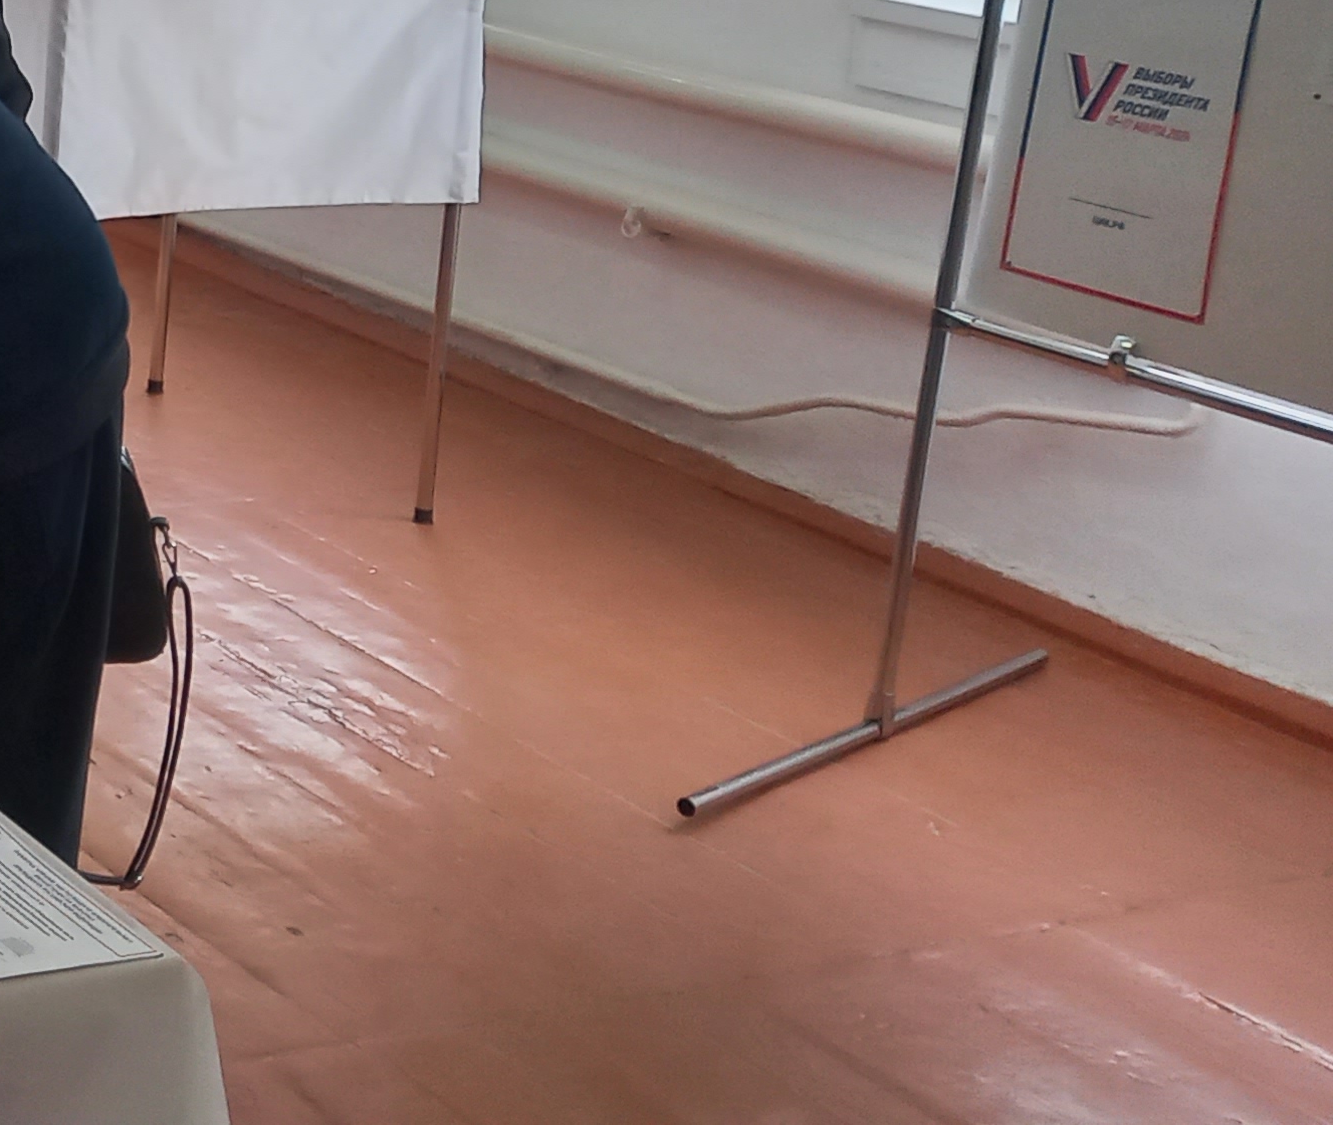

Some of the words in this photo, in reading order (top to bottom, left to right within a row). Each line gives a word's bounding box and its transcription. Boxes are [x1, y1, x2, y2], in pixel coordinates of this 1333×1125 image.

[1132, 66, 1196, 90] ВЫБОРЫ
[1122, 83, 1211, 112] ПРЕЗИДЕНТА
[1112, 100, 1170, 121] РОССИИ
